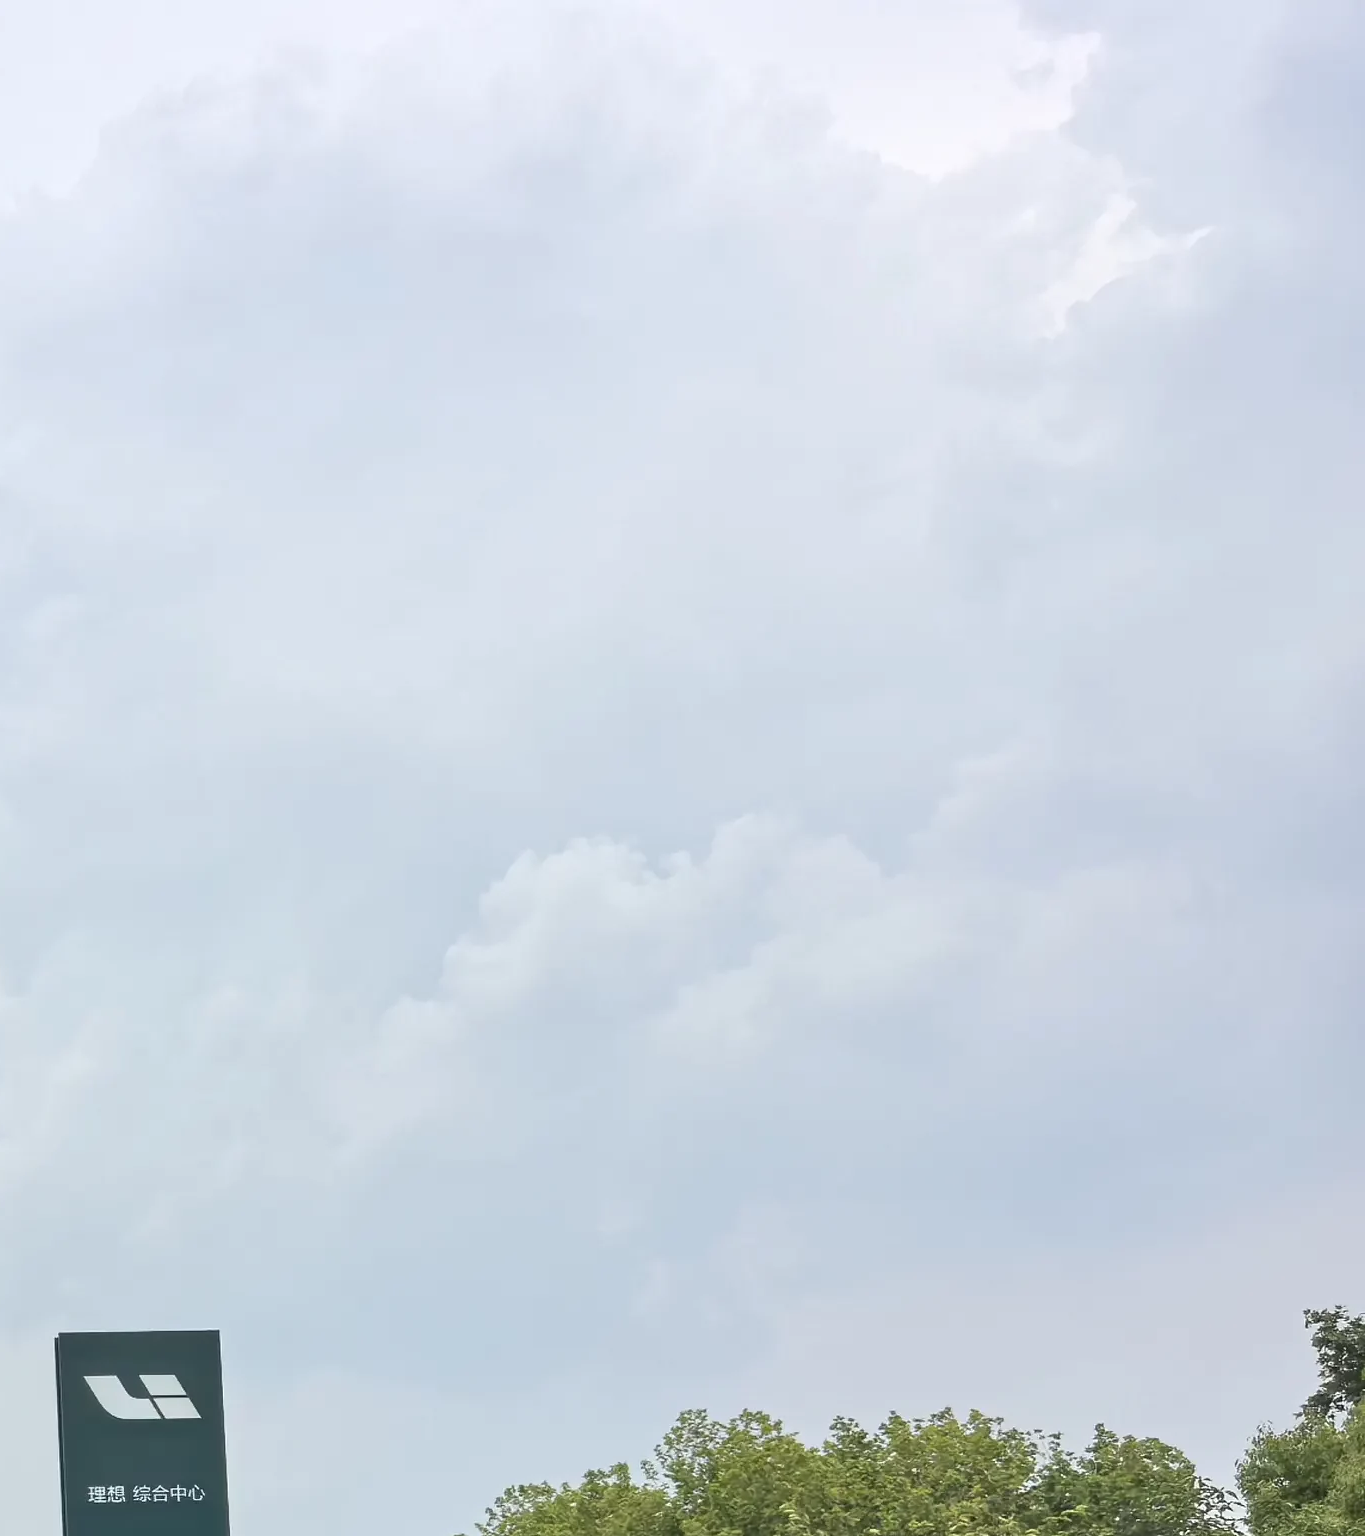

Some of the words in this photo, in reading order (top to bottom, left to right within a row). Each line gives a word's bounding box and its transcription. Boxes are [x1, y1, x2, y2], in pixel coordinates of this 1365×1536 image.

[87, 1485, 126, 1503] 理想
[132, 1484, 206, 1503] 综合中心
